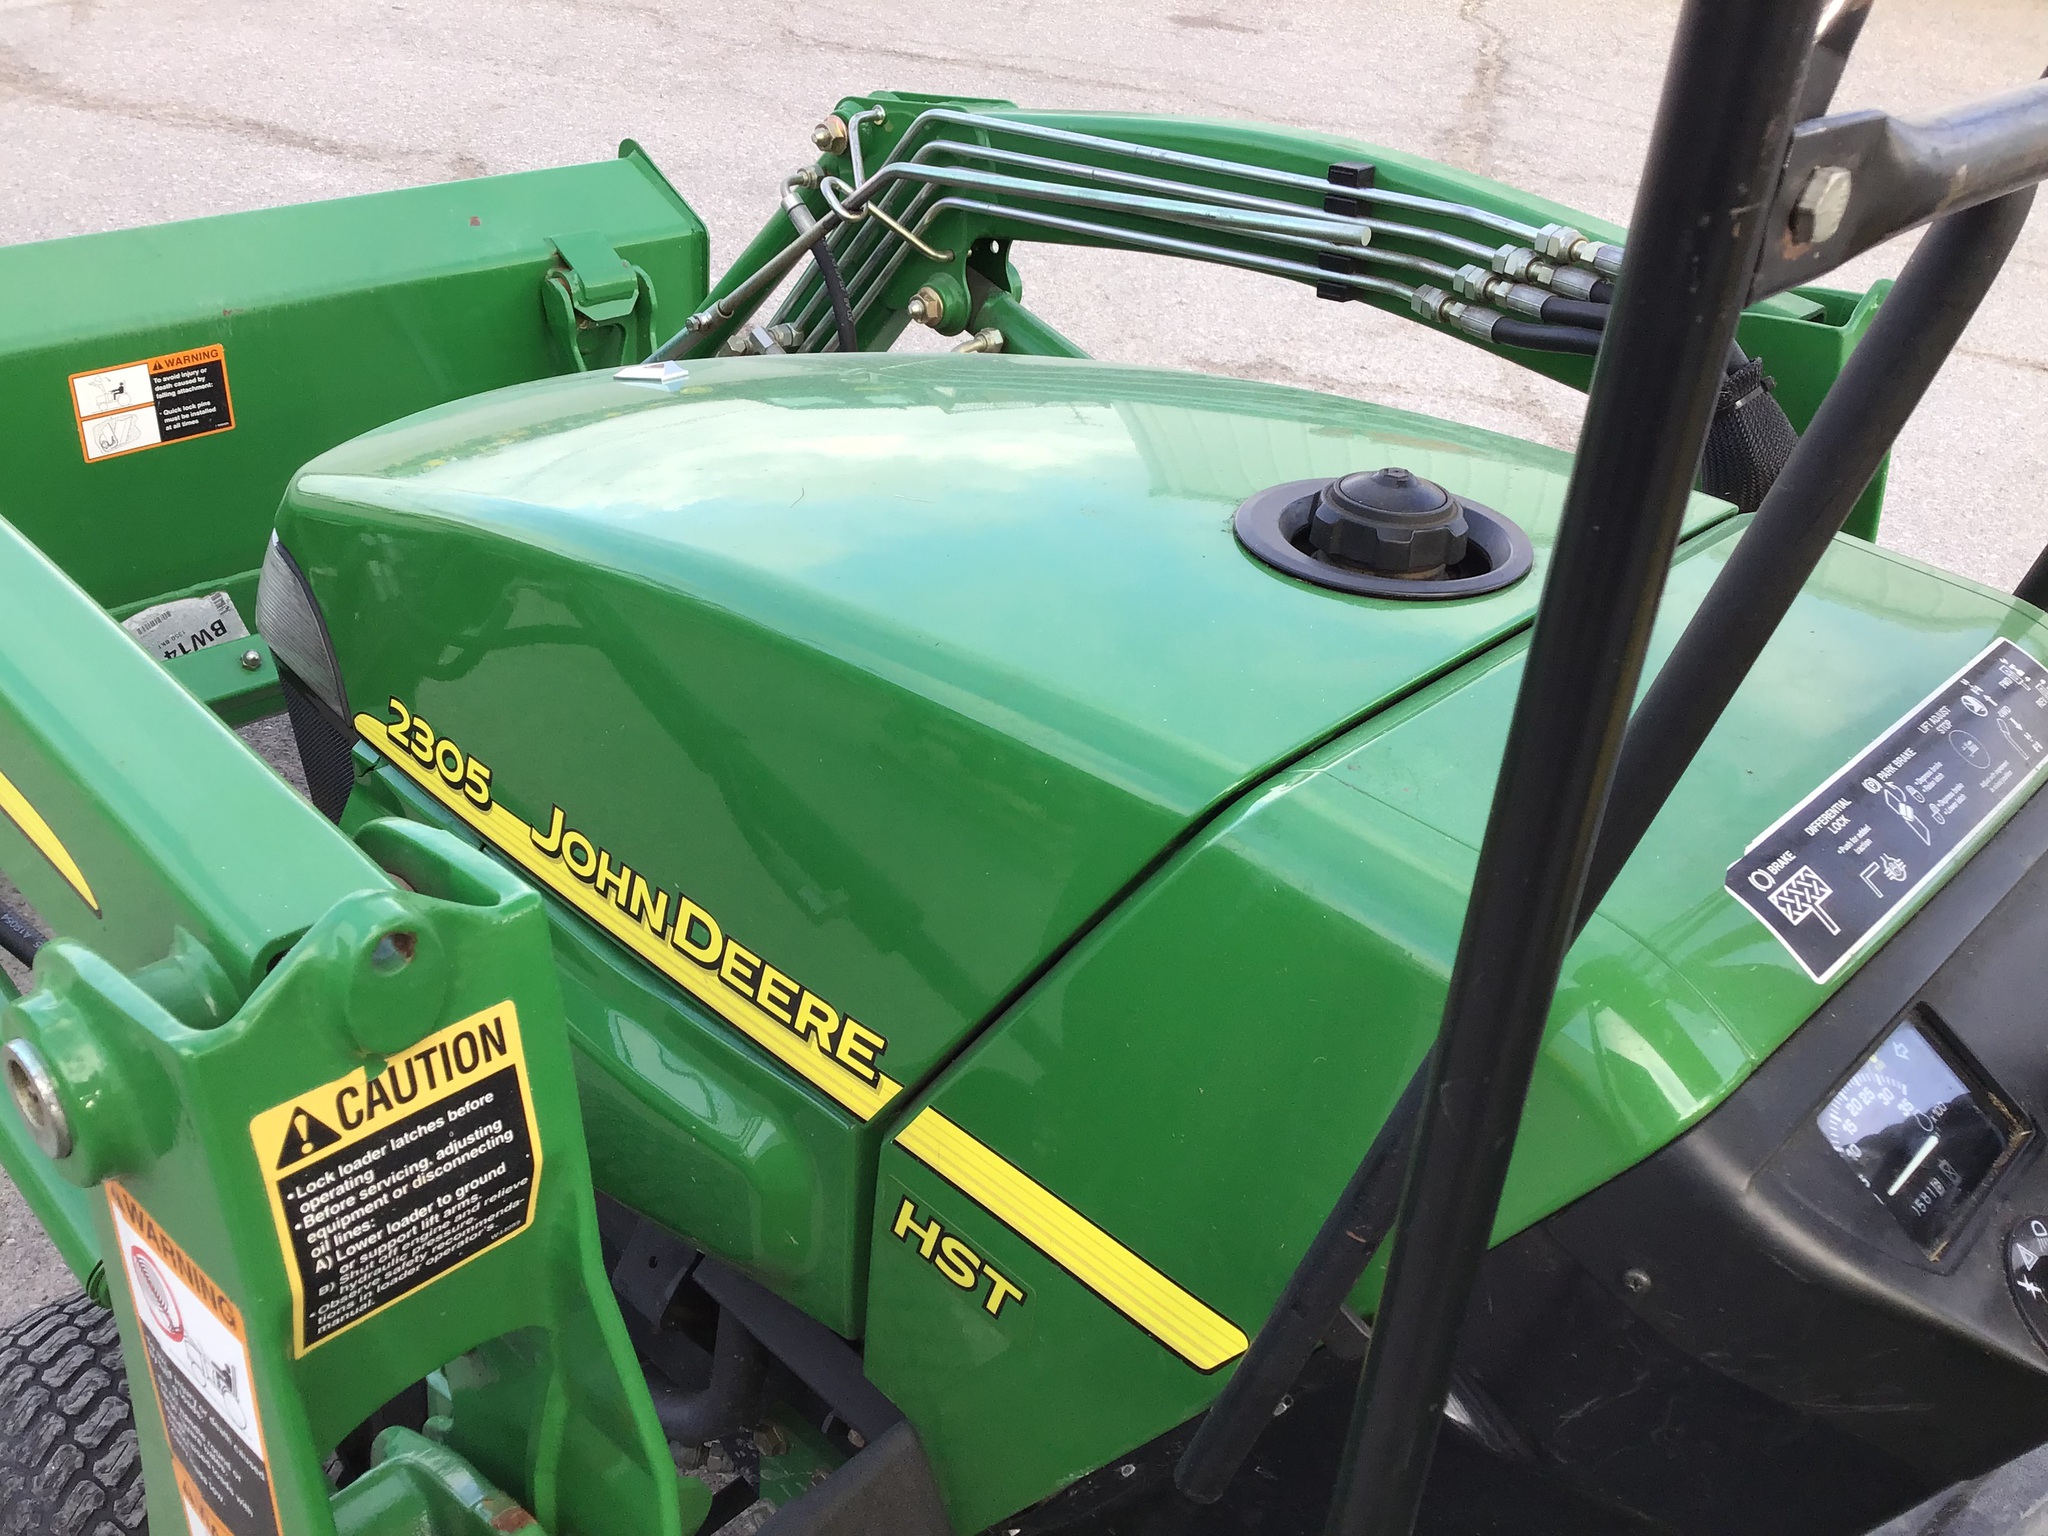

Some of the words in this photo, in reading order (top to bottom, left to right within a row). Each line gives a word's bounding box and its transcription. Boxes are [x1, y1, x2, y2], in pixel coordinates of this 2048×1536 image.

[165, 349, 218, 368] WARNING
[155, 383, 173, 392] death
[174, 378, 197, 387] caused
[156, 391, 176, 399] falling
[177, 382, 213, 395] attachment:
[163, 373, 181, 382] avoid
[181, 369, 199, 378] injury
[163, 406, 182, 416] Quick
[197, 400, 211, 408] pins
[164, 415, 180, 423] must
[190, 407, 217, 417] installed
[1917, 721, 1934, 734] LIFT
[1929, 705, 1951, 725] ADJUST
[1936, 719, 1953, 735] STOP
[1997, 705, 2012, 718] 4WD
[387, 698, 492, 809] 2305
[1876, 762, 1898, 781] PARK
[1892, 747, 1917, 769] BRAKE
[1804, 797, 1852, 837] DIFFERENTIAL
[1827, 814, 1851, 835] LOCK
[1839, 840, 1851, 854] Push
[1850, 834, 1859, 845] for
[1857, 824, 1872, 838] added
[1853, 838, 1873, 855] traction
[1766, 850, 1797, 876] BRAKE
[531, 806, 668, 932] JOHN
[672, 895, 886, 1082] DEERE
[336, 1016, 507, 1131] CAUTION
[1846, 1097, 1864, 1118] 20
[1858, 1086, 1876, 1106] 25
[1877, 1087, 1895, 1106] 30
[1897, 1097, 1915, 1117] 35
[1842, 1118, 1858, 1136] 15
[295, 1171, 336, 1199] Lock
[338, 1145, 388, 1178] loader
[390, 1117, 445, 1151] latches
[447, 1092, 494, 1122] before
[1845, 1143, 1863, 1161] 10
[303, 1197, 356, 1229] Before
[435, 1119, 503, 1162] adjusting
[306, 1193, 389, 1244] equipment
[392, 1183, 409, 1199] or
[412, 1128, 514, 1189] disconnecting
[300, 1169, 375, 1214] operating
[315, 1256, 333, 1274] A)
[335, 1230, 384, 1262] Lower
[386, 1201, 433, 1235] loader
[436, 1194, 452, 1207] to
[455, 1162, 506, 1199] ground
[338, 1262, 356, 1275] or
[359, 1225, 418, 1264] support
[421, 1213, 440, 1231] lift
[443, 1193, 482, 1218] arms.
[310, 1239, 332, 1258] oil
[334, 1218, 376, 1248] lines:
[318, 1283, 336, 1297] B)
[339, 1264, 375, 1285] Shut
[378, 1246, 398, 1260] off
[401, 1219, 451, 1251] engine
[454, 1202, 481, 1223] and
[484, 1177, 529, 1206] relieve
[123, 1194, 237, 1330] WARNING
[317, 1278, 381, 1315] Observe
[384, 1251, 428, 1280] safety
[431, 1198, 526, 1254] recommenda-
[340, 1251, 408, 1294] hydraulic
[412, 1217, 477, 1256] pressure.
[892, 1197, 1025, 1316] HST
[317, 1299, 355, 1325] tions
[359, 1290, 373, 1302] in
[376, 1262, 422, 1293] loader
[317, 1302, 376, 1335] manual.
[233, 1444, 266, 1481] caused
